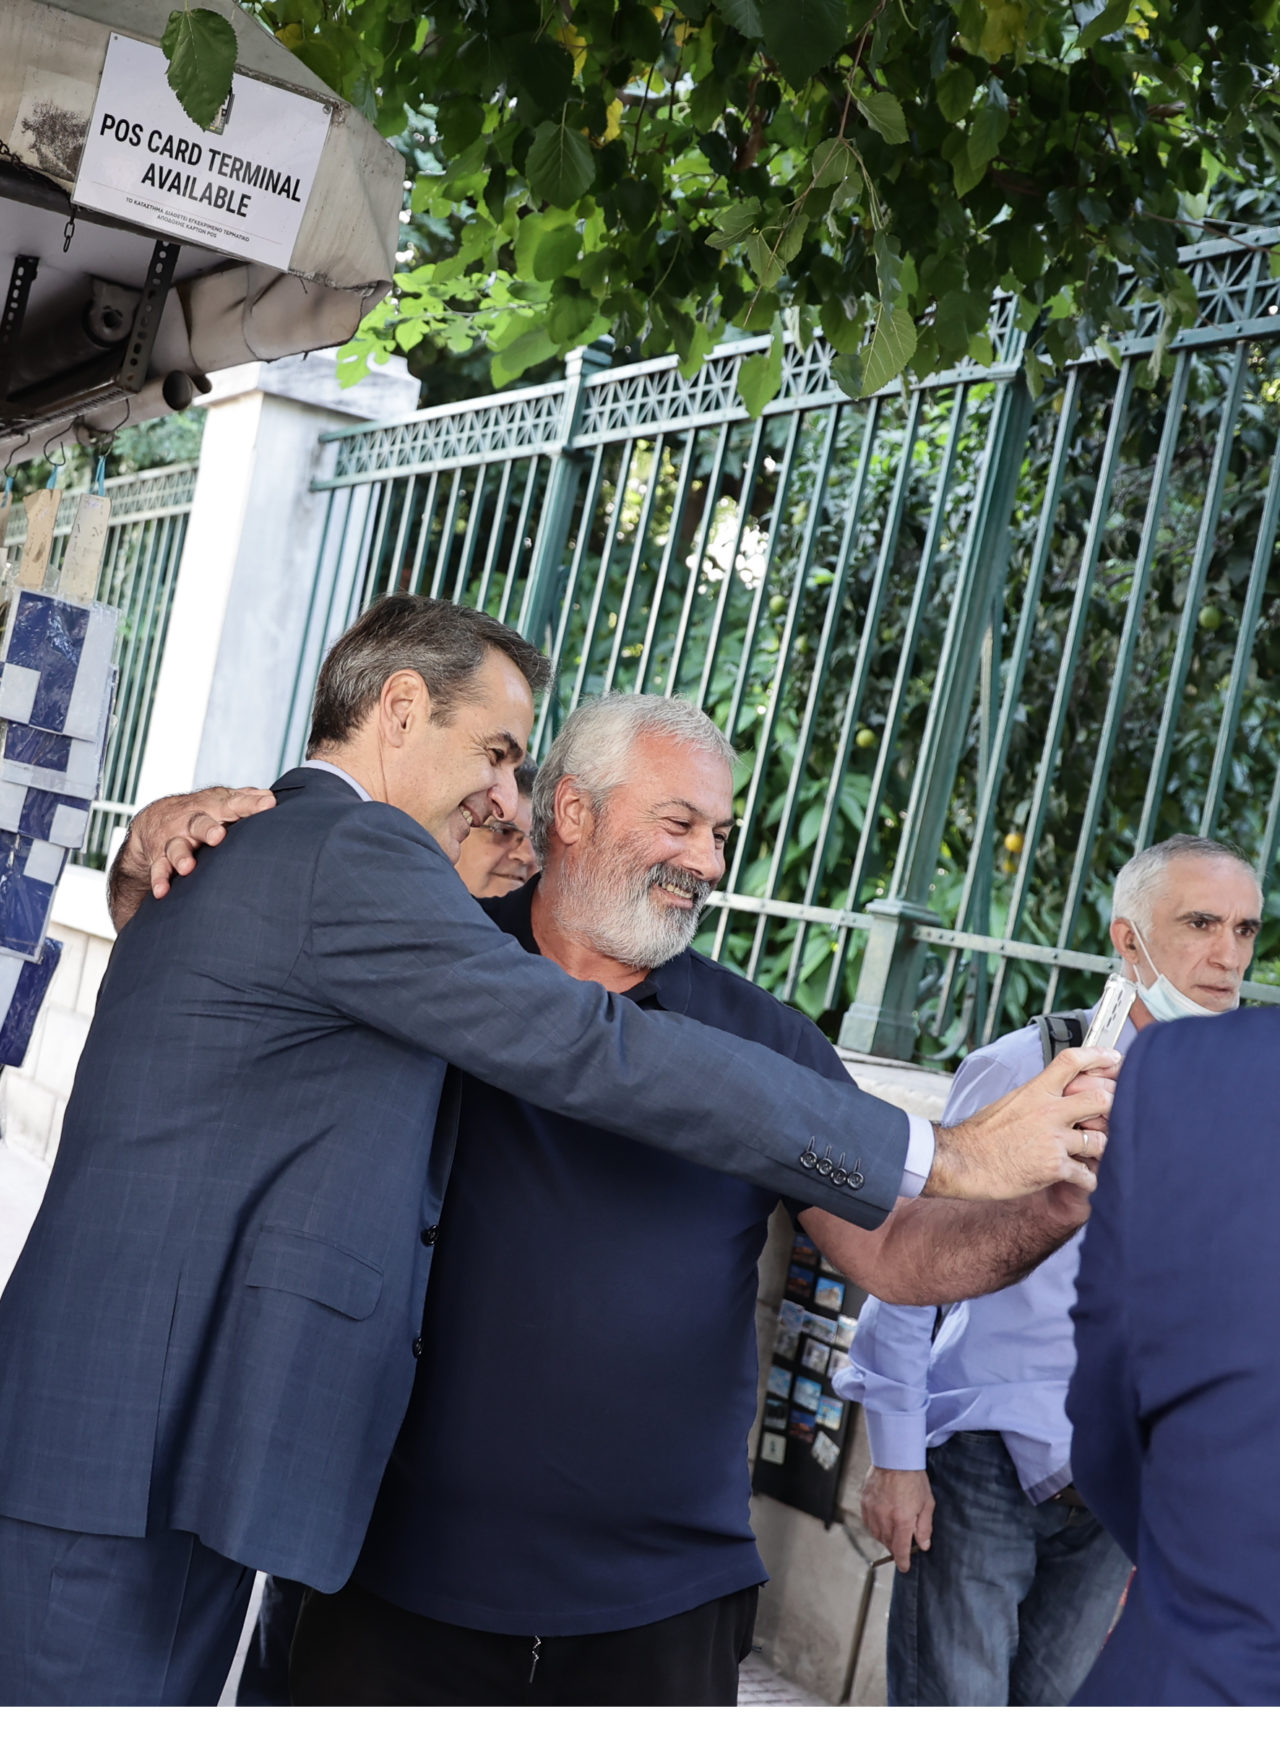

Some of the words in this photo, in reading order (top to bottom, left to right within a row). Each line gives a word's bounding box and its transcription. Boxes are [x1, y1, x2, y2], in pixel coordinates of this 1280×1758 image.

[100, 113, 144, 147] POS
[147, 129, 202, 166] CARD
[208, 149, 301, 203] TERMINAL
[141, 162, 252, 218] AVAILABLE
